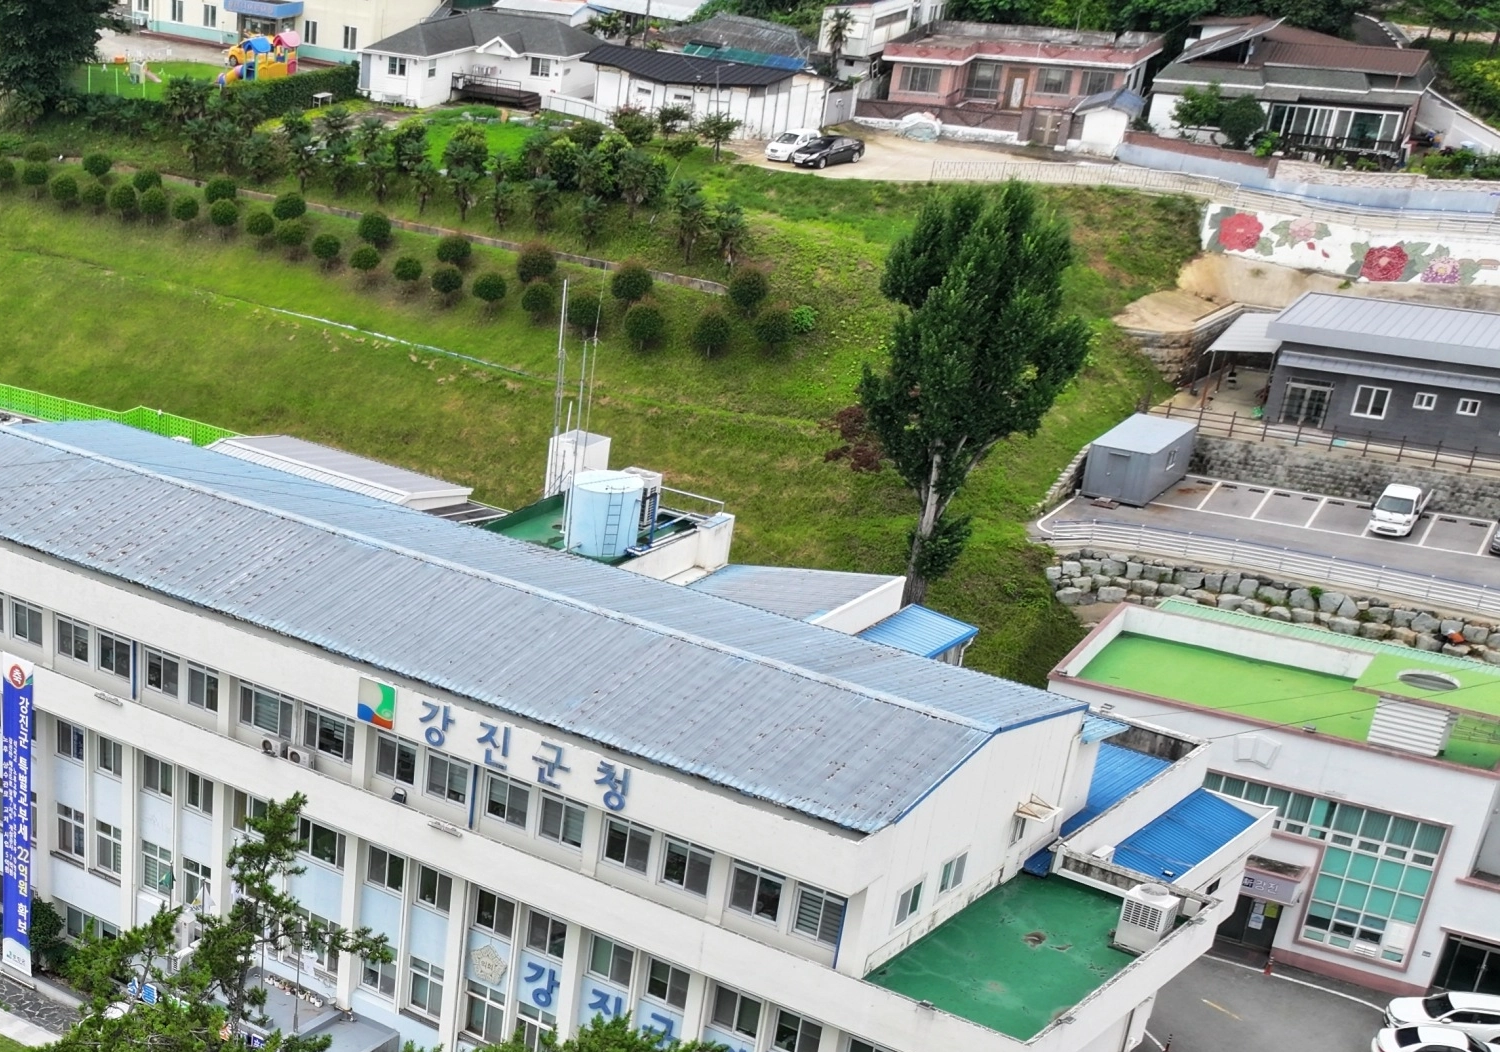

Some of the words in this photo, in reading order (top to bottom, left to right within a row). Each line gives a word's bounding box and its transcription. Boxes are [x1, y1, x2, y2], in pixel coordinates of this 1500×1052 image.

[12, 669, 23, 684] 축
[18, 696, 30, 749] 강진군
[418, 699, 632, 812] 강진군청
[17, 756, 30, 842] 특별교부세
[16, 845, 30, 897] 22억원
[17, 903, 29, 936] 확보
